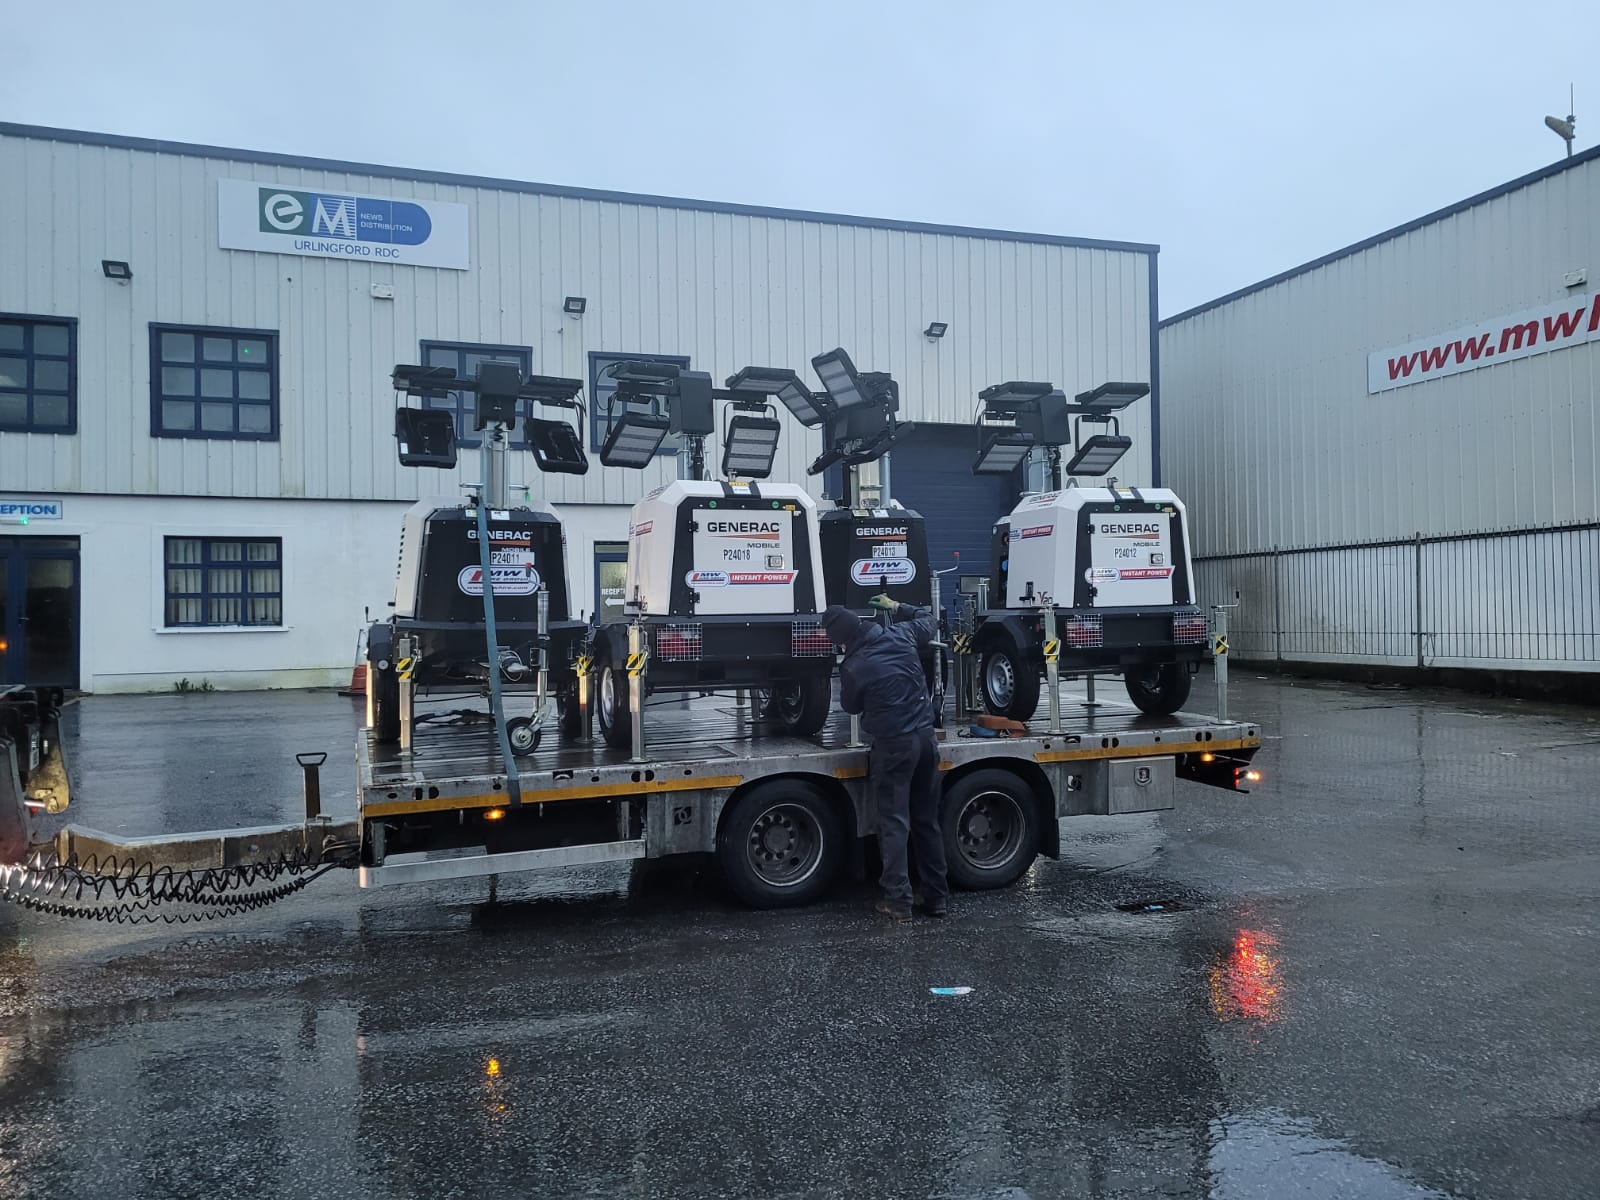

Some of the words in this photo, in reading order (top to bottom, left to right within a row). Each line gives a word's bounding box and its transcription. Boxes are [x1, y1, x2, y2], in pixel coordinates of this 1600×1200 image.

[360, 212, 384, 222] NEWS
[360, 221, 413, 232] DISTRIBUTION
[294, 239, 371, 256] URLINGFORD
[375, 247, 400, 259] RDC
[707, 521, 781, 533] GENERAC
[856, 527, 908, 536] GENERAC
[1101, 523, 1160, 534] GENERAC
[723, 549, 751, 561] P24018
[873, 546, 896, 557] P24013
[1114, 547, 1137, 559] P24012
[491, 553, 520, 564] P24011
[731, 573, 762, 582] INSTANT
[763, 573, 788, 581] POWER
[1146, 569, 1167, 577] POWER
